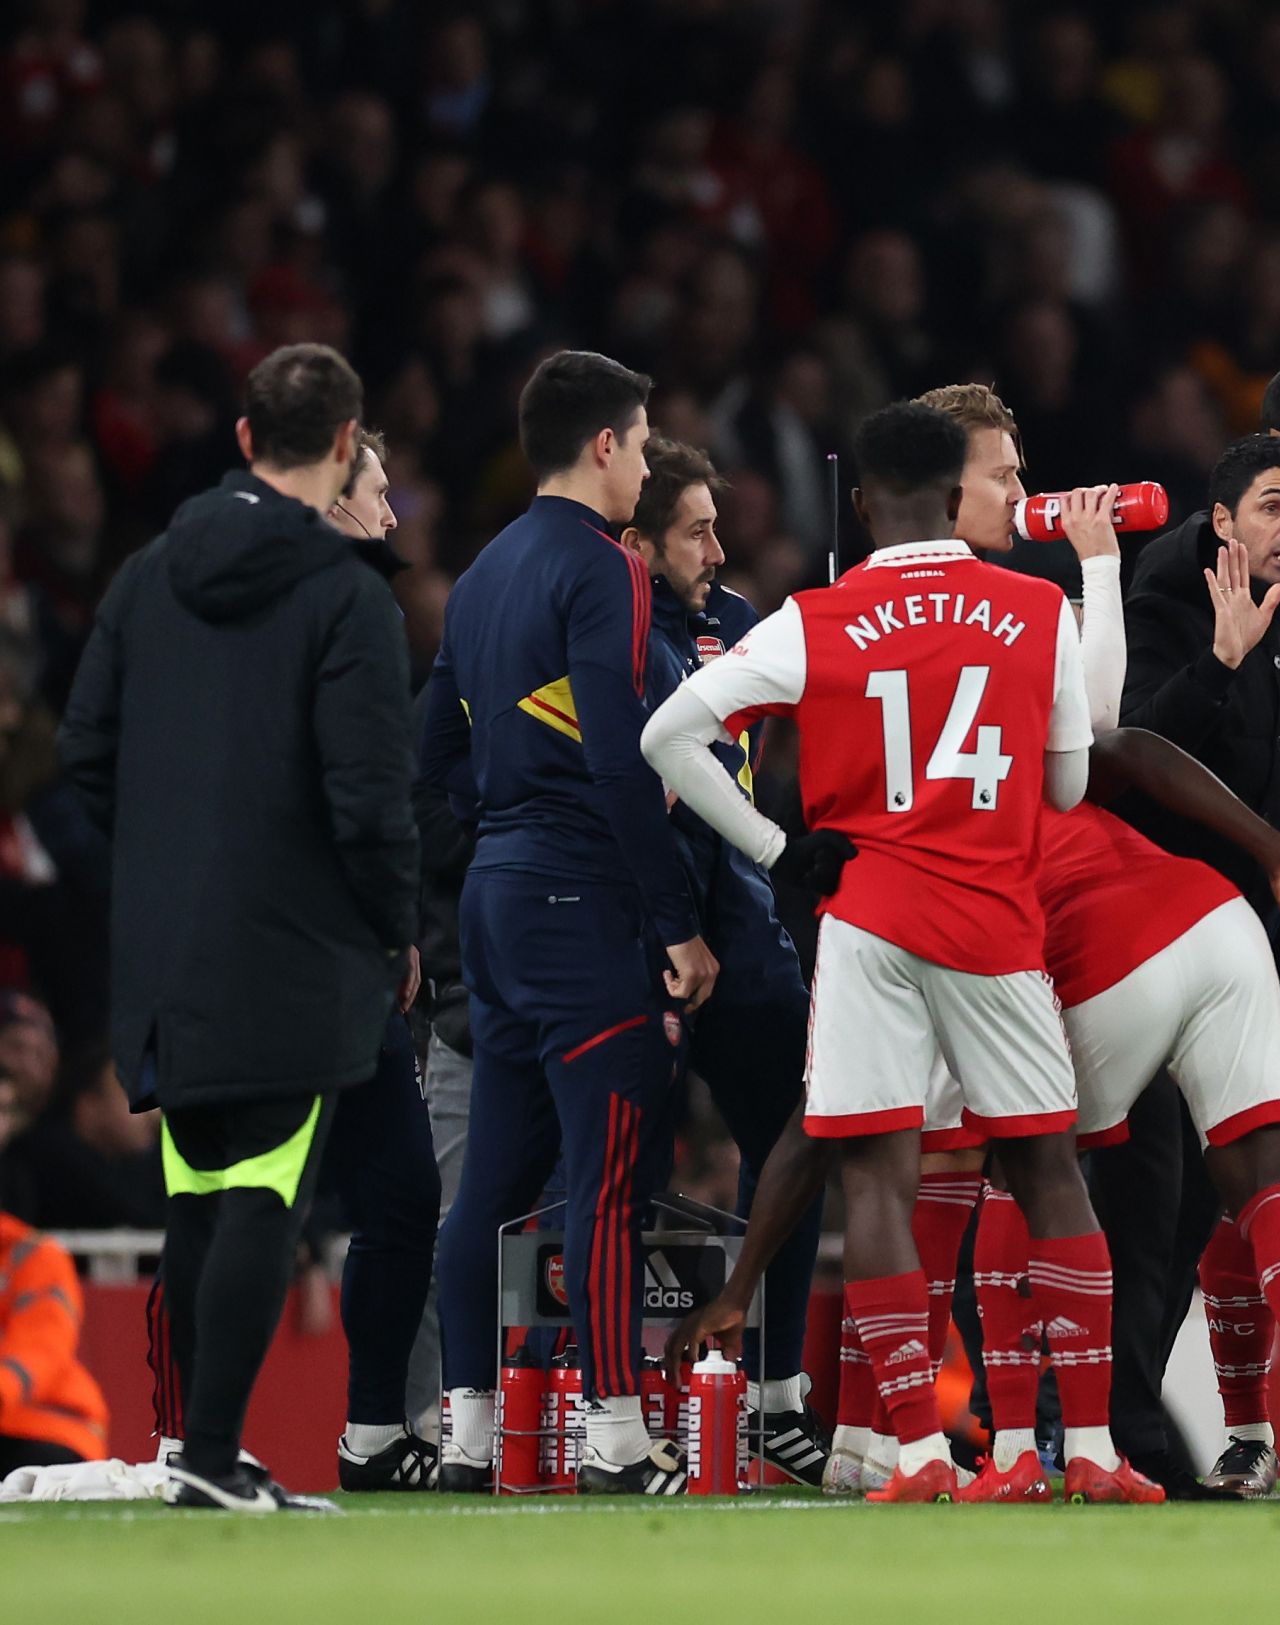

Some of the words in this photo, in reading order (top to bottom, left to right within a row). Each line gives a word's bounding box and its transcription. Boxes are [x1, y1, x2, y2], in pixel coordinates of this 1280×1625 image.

[901, 570, 946, 579] ARSENAL
[845, 594, 1027, 651] NKETIAH
[865, 665, 1015, 814] 14
[643, 1288, 699, 1309] idas
[1209, 1318, 1256, 1336] AFC
[687, 1396, 702, 1479] PRIME
